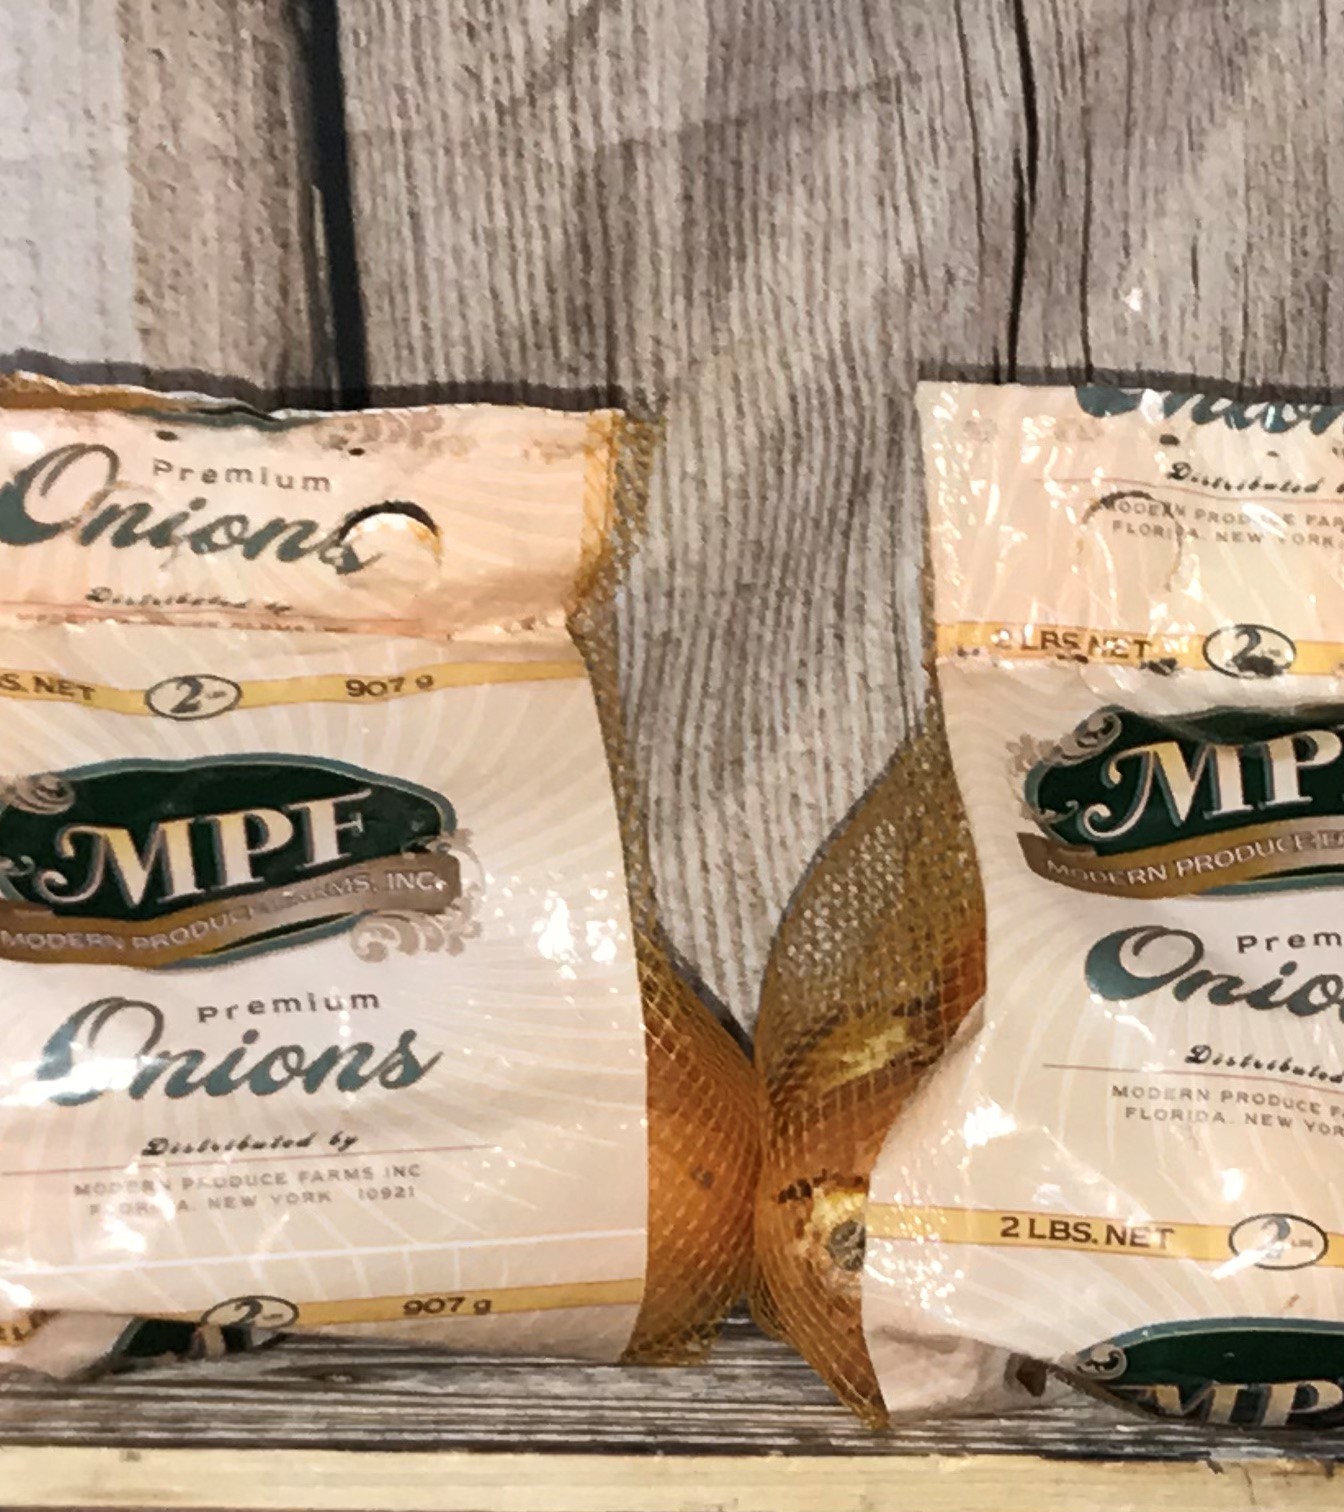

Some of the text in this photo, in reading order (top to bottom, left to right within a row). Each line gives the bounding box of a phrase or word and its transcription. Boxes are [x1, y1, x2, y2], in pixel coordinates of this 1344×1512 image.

[153, 459, 332, 492] Premium
[32, 675, 95, 700] NET
[170, 677, 203, 713] 2
[346, 676, 406, 697] 907
[32, 788, 372, 909] MPF
[1046, 857, 1167, 888] MODERN
[0, 928, 126, 951] MODERN
[197, 992, 380, 1024] Premium
[36, 996, 443, 1107] Onions
[1111, 1084, 1210, 1101] MODERN
[1219, 1089, 1322, 1115] PRODUCE
[1245, 1112, 1293, 1129] NEW
[298, 1166, 374, 1184] FARMS
[208, 1195, 256, 1210] NEW
[269, 1190, 333, 1205] YORK
[358, 1186, 416, 1201] 10921
[999, 1217, 1175, 1251] 2 LBS. NET
[402, 1296, 492, 1317] 907 g
